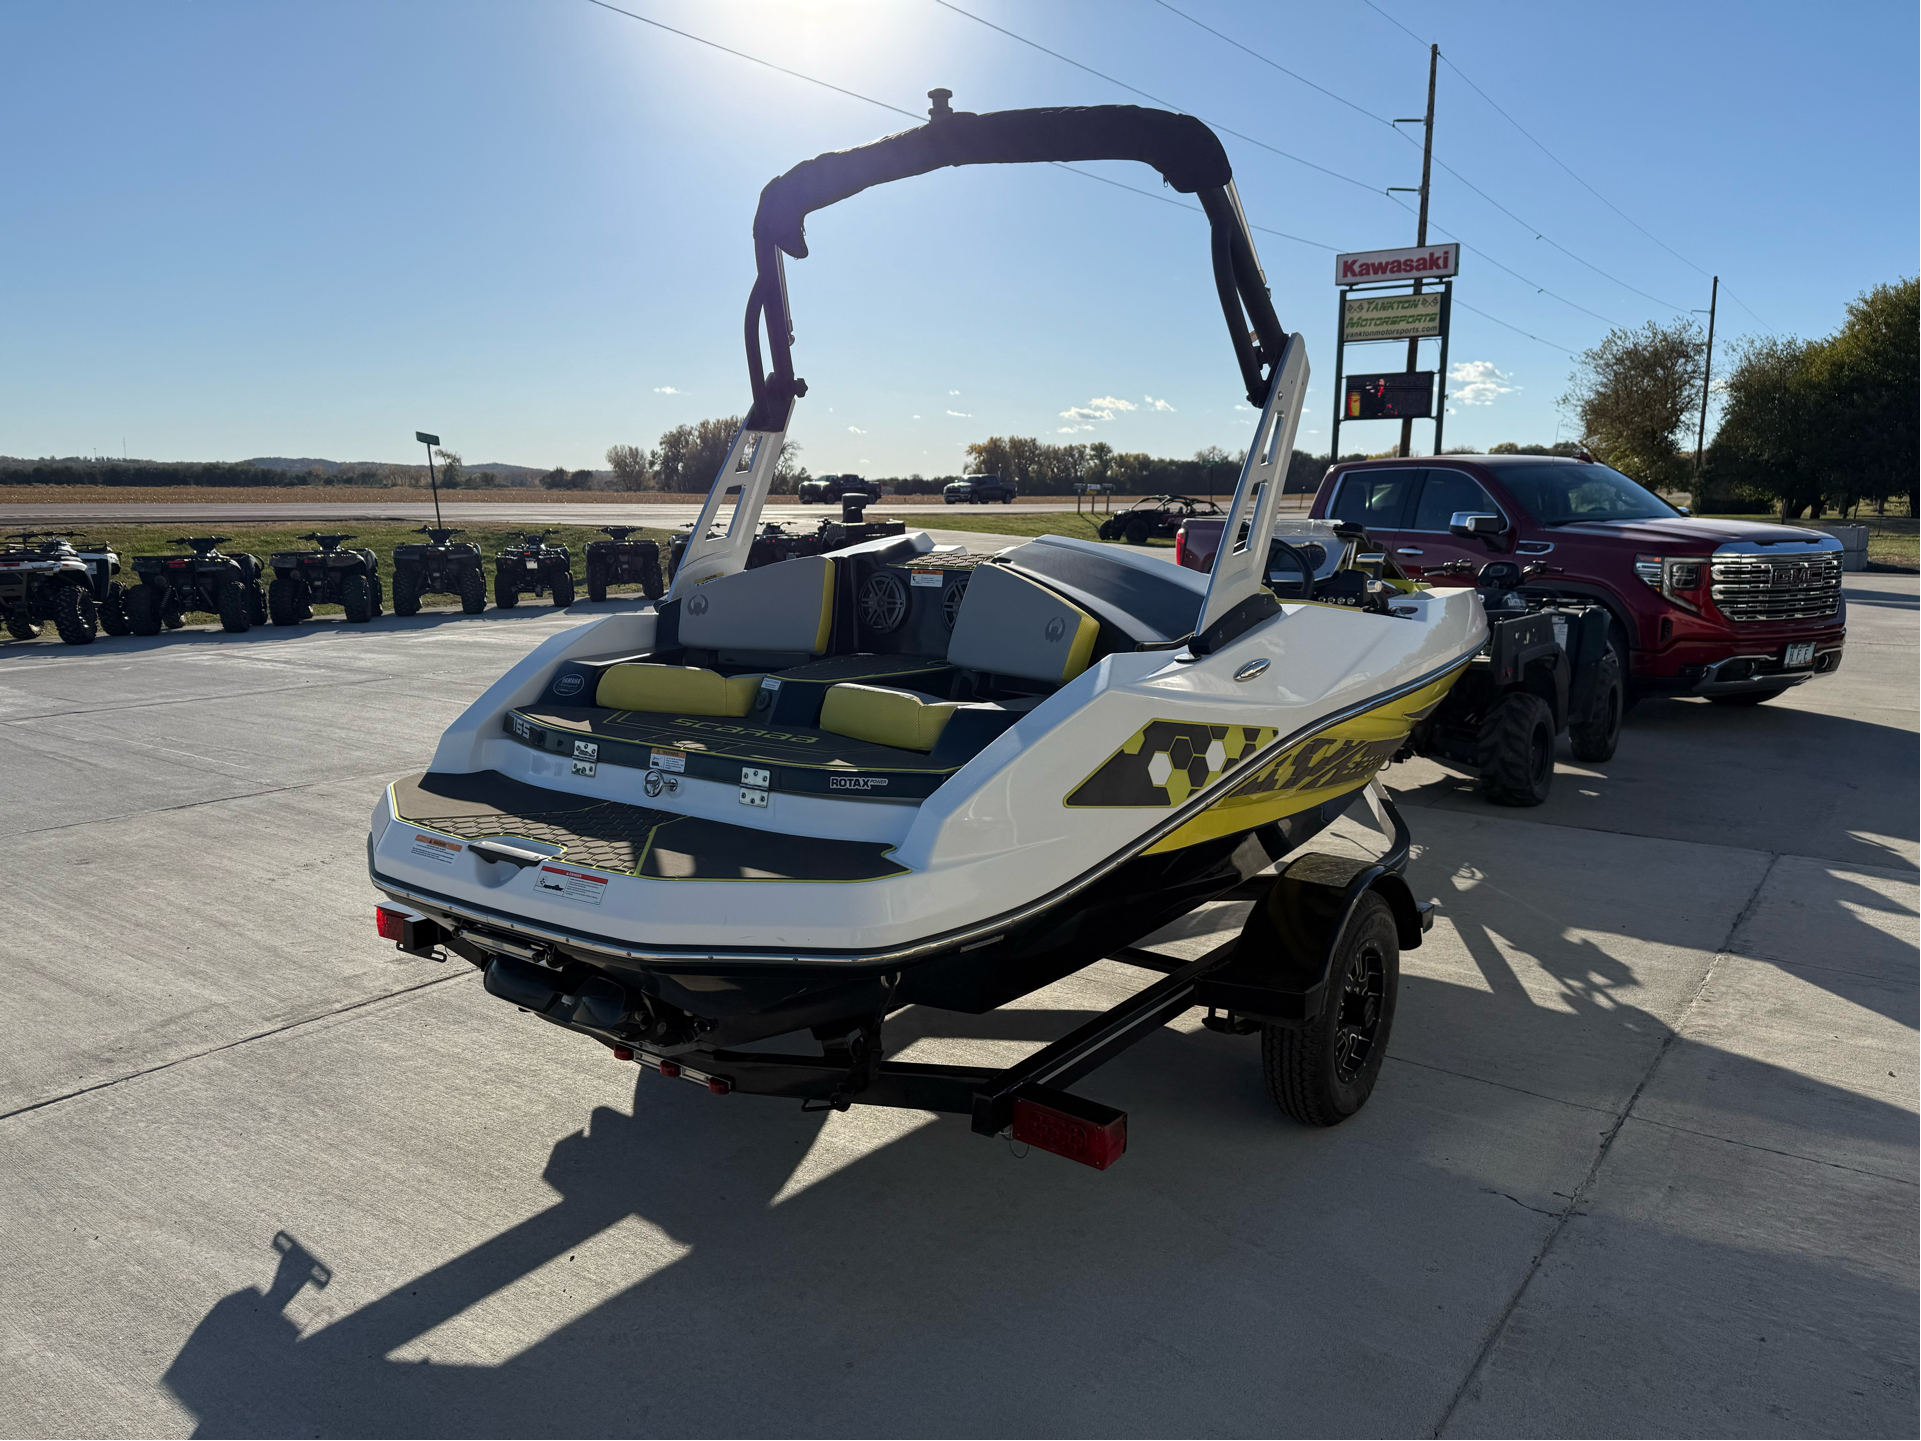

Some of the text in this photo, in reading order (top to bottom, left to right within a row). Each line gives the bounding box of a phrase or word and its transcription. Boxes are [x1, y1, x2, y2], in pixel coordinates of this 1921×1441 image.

[1342, 251, 1449, 278] Kawasaki
[1366, 299, 1420, 312] YANKTON
[1346, 312, 1438, 329] MOTORSPORTS
[1345, 325, 1438, 339] yanktonmotorsports.com
[1774, 569, 1821, 583] GMC
[513, 717, 530, 739] 165
[830, 776, 871, 789] ROTAX
